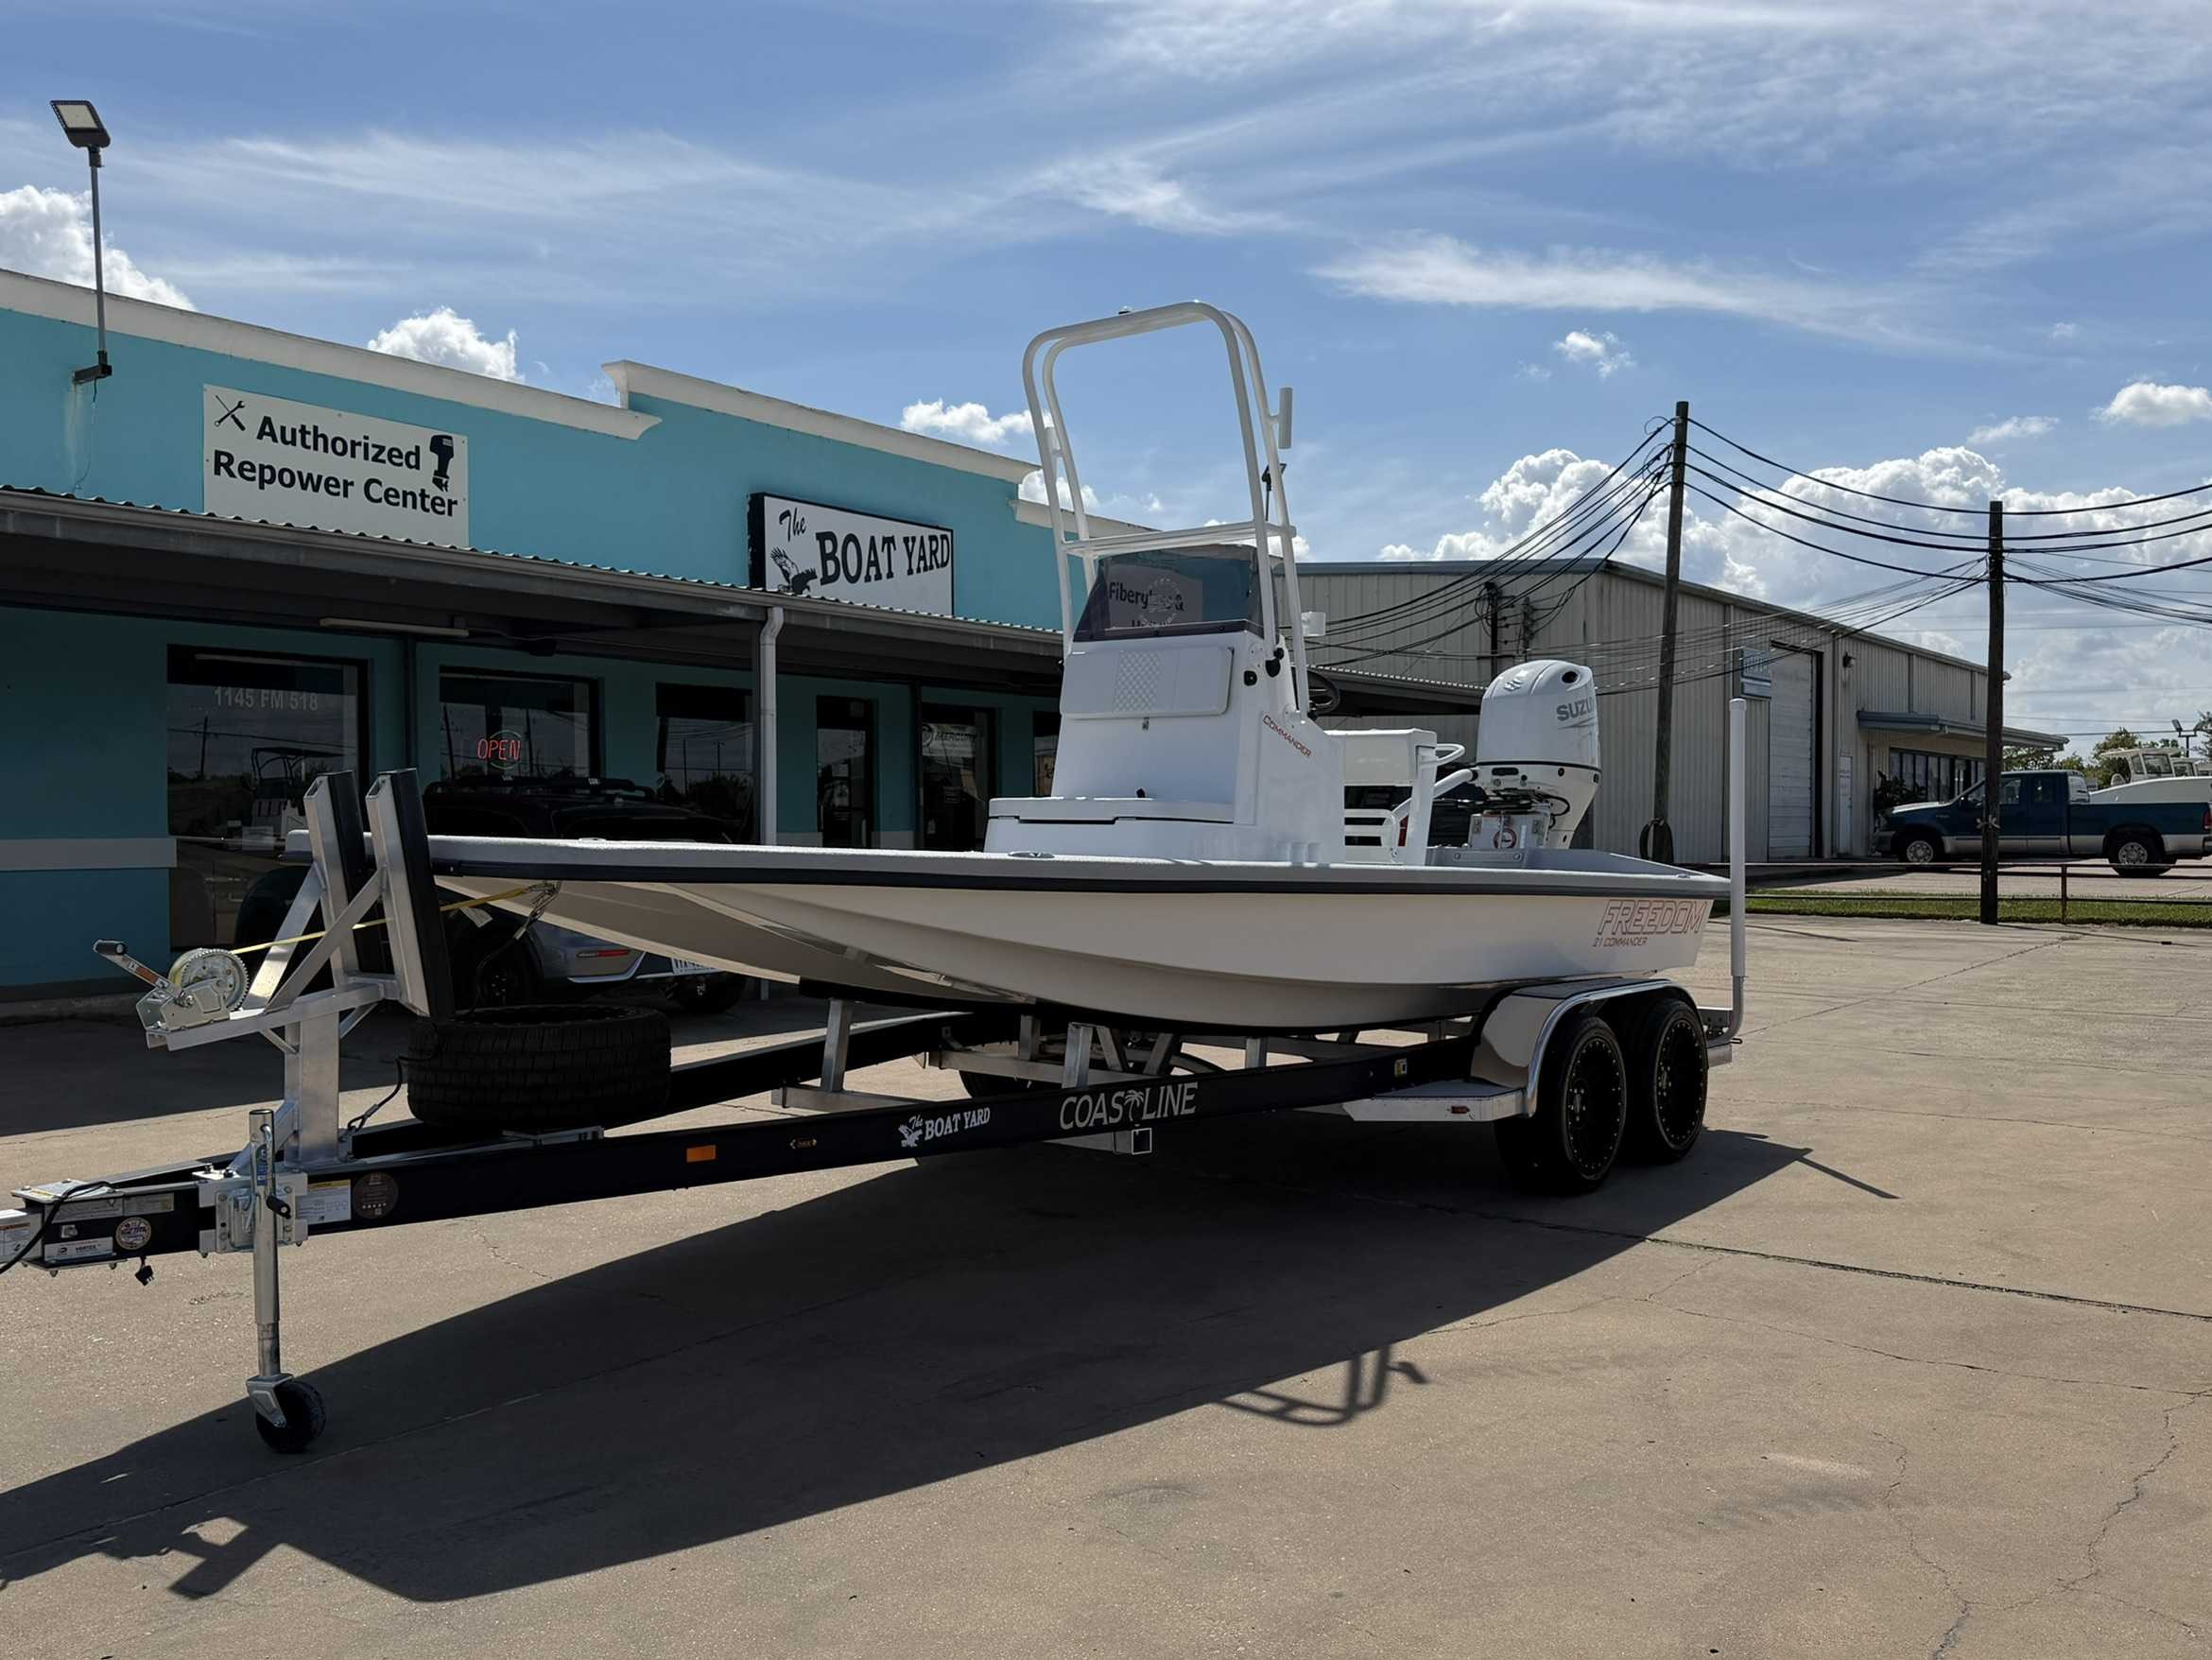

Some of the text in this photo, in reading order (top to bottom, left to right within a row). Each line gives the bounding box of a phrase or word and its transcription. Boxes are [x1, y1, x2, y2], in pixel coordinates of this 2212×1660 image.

[256, 415, 421, 471] Authorized
[213, 449, 458, 518] Repower Center
[778, 507, 806, 543] The
[815, 530, 951, 586] BOAT YARD
[214, 685, 319, 711] 1145 FM 518
[476, 737, 522, 761] OPEN
[1262, 714, 1312, 757] COMMANDER
[1597, 899, 1709, 936] FREEDOM
[1604, 936, 1649, 947] COMMANDER
[925, 1107, 991, 1141] BOAT YARD
